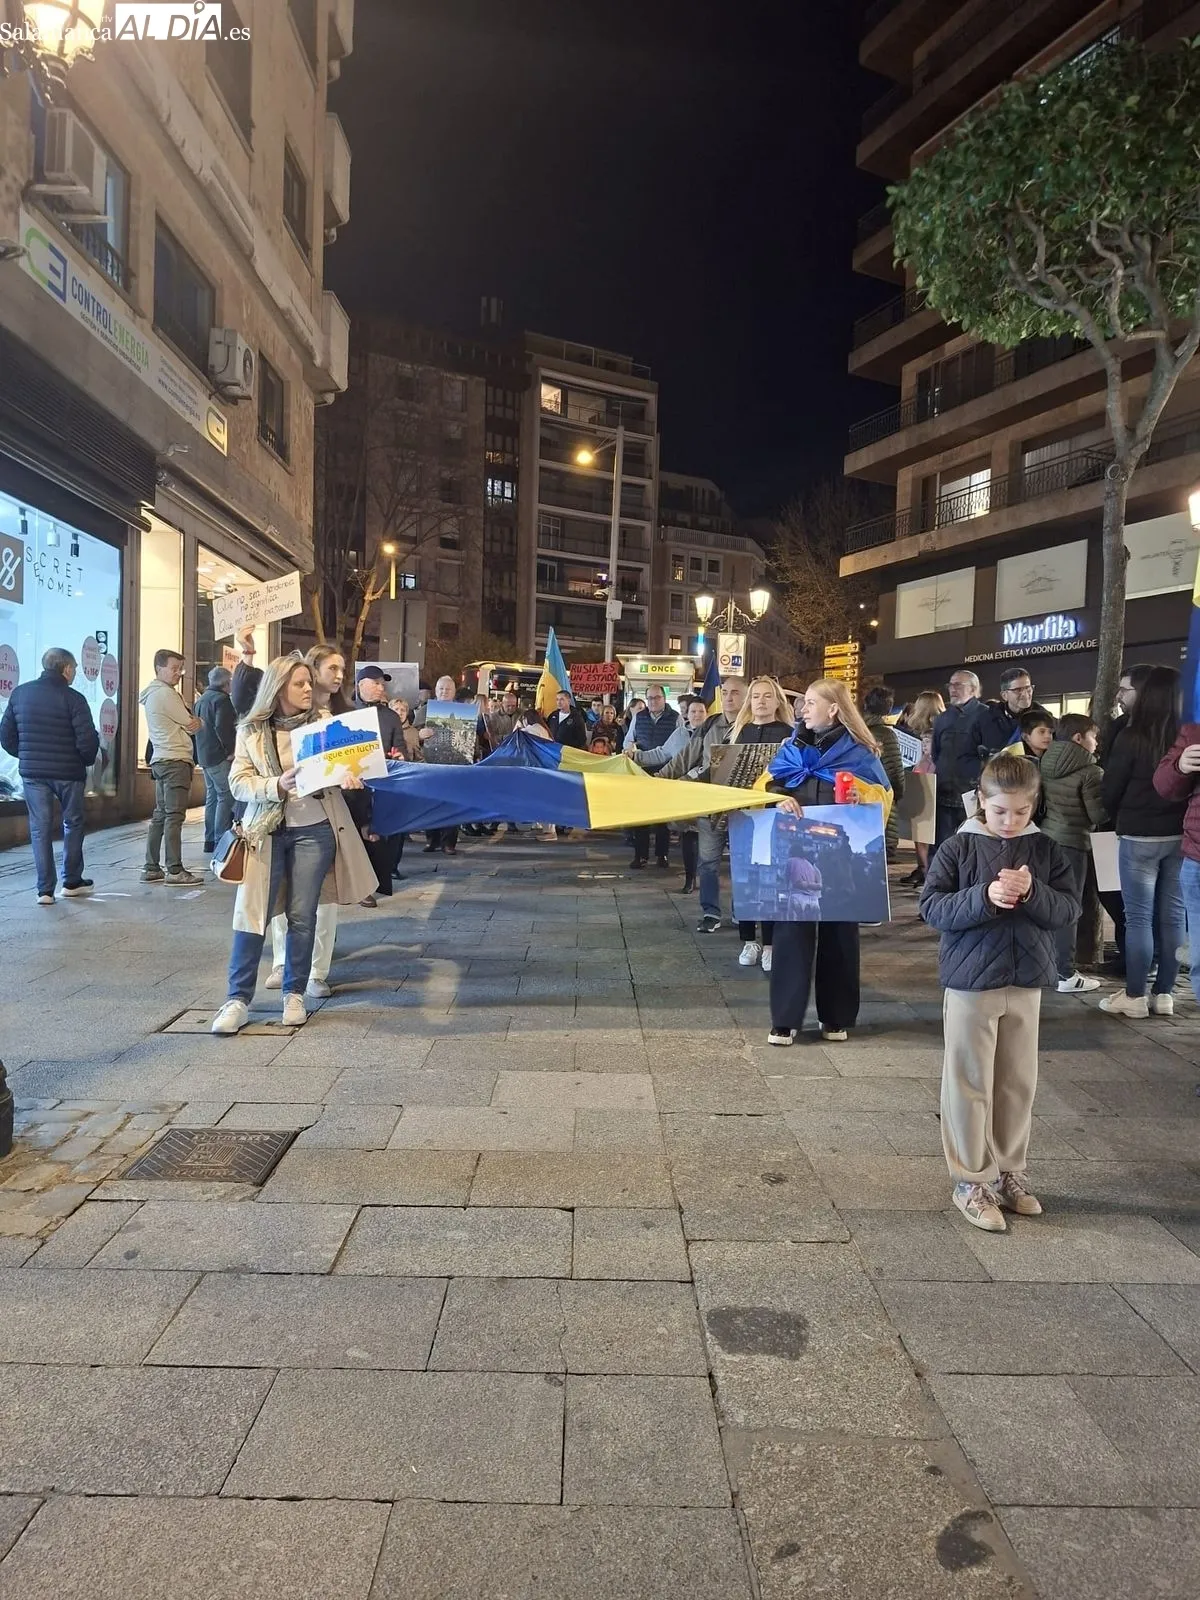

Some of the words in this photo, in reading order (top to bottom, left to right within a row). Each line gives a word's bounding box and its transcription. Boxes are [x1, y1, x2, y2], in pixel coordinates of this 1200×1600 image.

[216, 597, 234, 614] Que
[237, 595, 245, 606] no
[240, 603, 249, 612] no
[1003, 614, 1077, 645] Marfila
[964, 652, 994, 663] MEDICINA
[995, 648, 1024, 660] ESTÉTICA
[1025, 647, 1031, 655] Y
[1031, 639, 1085, 654] ODONTOLOGÍA
[1086, 639, 1098, 648] DE
[571, 664, 599, 673] RUSIA
[602, 664, 615, 672] ES
[586, 673, 618, 682] ESTADO
[570, 682, 616, 692] TERRORISTA
[330, 733, 364, 746] escucha
[344, 747, 355, 756] en
[356, 742, 380, 753] lucha
